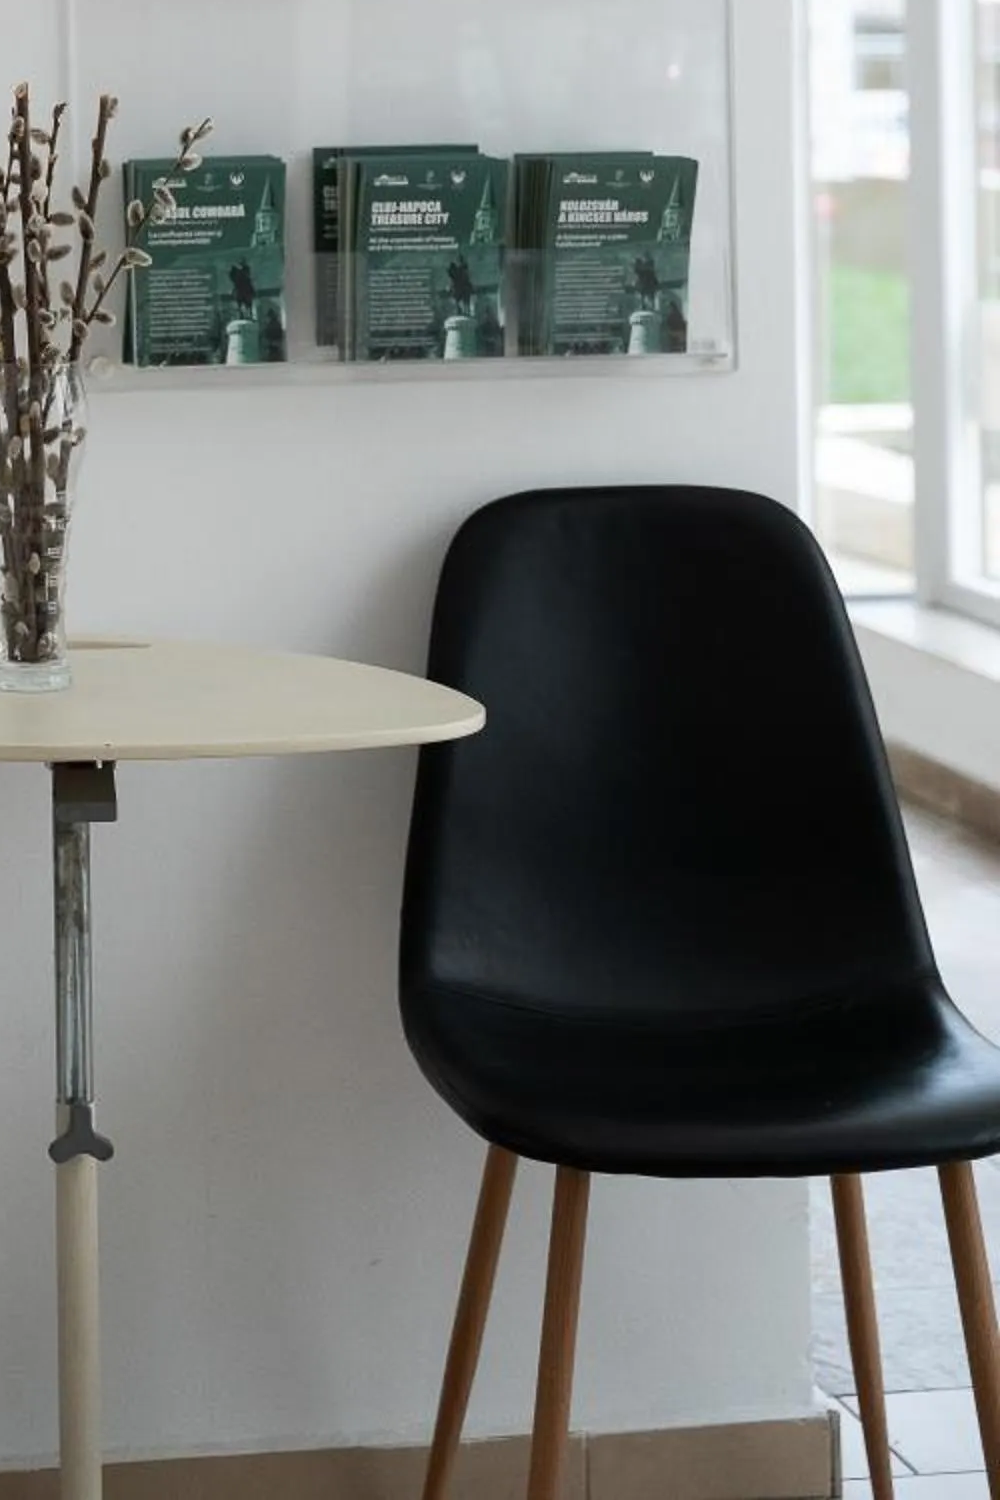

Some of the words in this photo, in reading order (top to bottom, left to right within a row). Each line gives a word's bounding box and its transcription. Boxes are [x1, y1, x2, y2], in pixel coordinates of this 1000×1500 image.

[371, 201, 442, 213] CLUJ-NAPOCA
[371, 213, 423, 225] TREASURE
[424, 212, 450, 225] CITY
